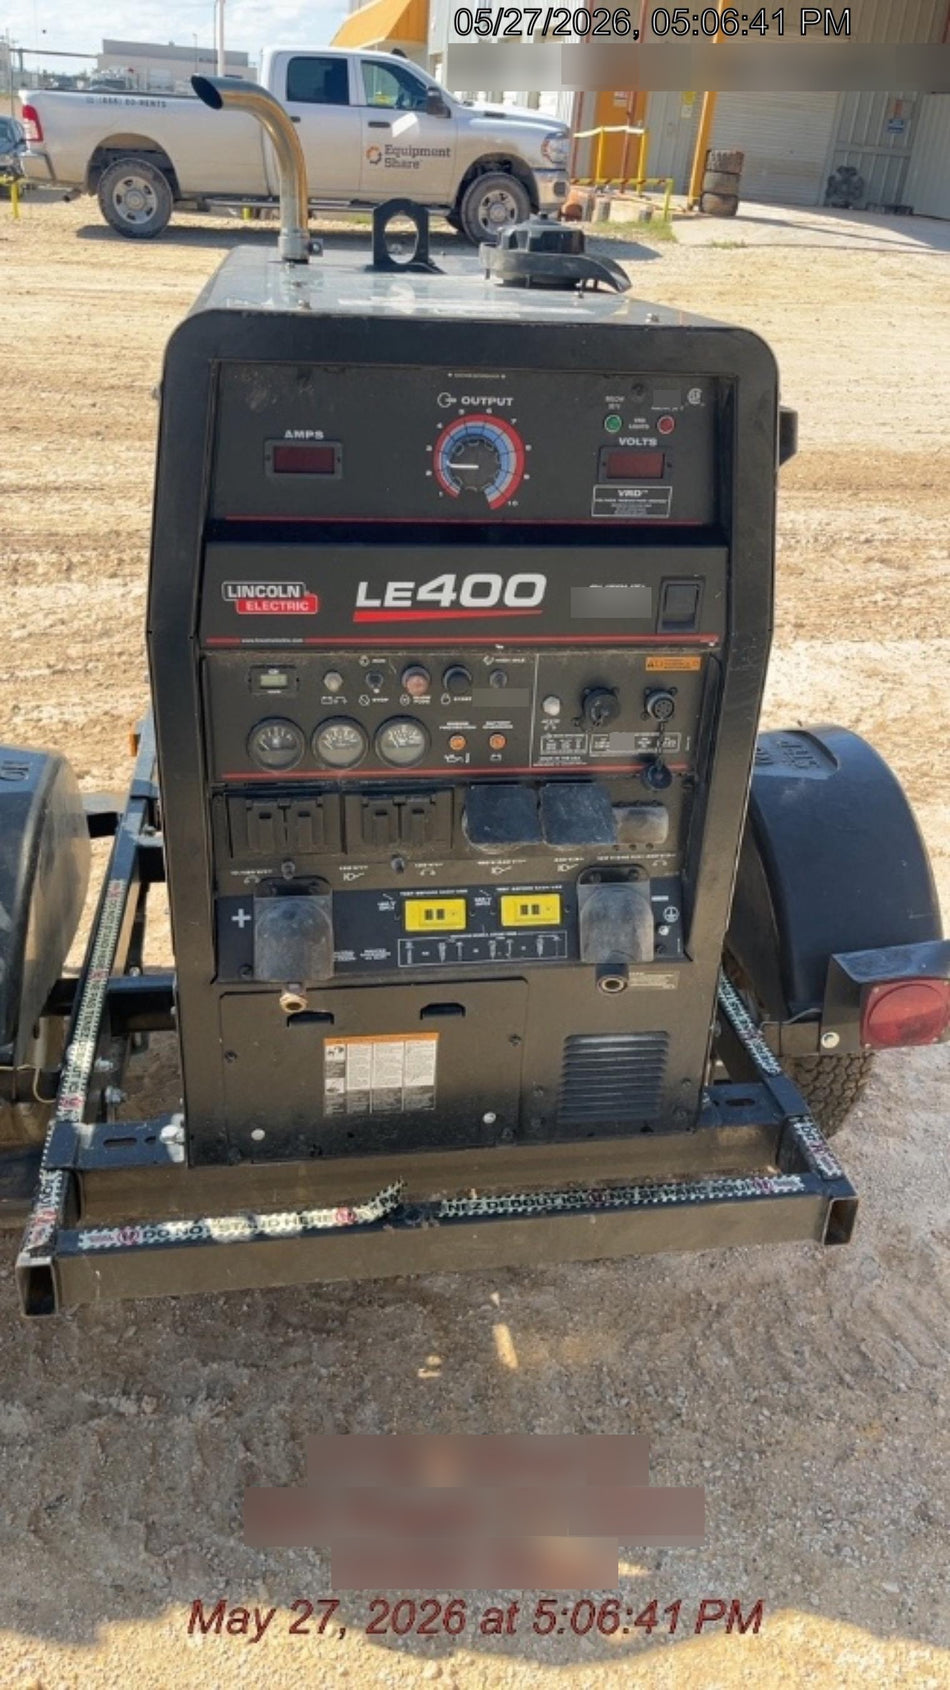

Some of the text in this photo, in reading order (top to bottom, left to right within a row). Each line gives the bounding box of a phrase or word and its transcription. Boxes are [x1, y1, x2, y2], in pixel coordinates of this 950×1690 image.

[385, 144, 451, 158] Equipment
[385, 157, 421, 169] Share
[461, 396, 514, 406] OUTPUT
[284, 430, 324, 440] AMPS
[619, 437, 658, 446] VOLTS
[228, 585, 301, 598] LINCOLN
[355, 573, 547, 608] LE400
[246, 600, 310, 611] ELECTRIC
[487, 1196, 557, 1209] DEBOUT
[143, 1229, 170, 1239] DO
